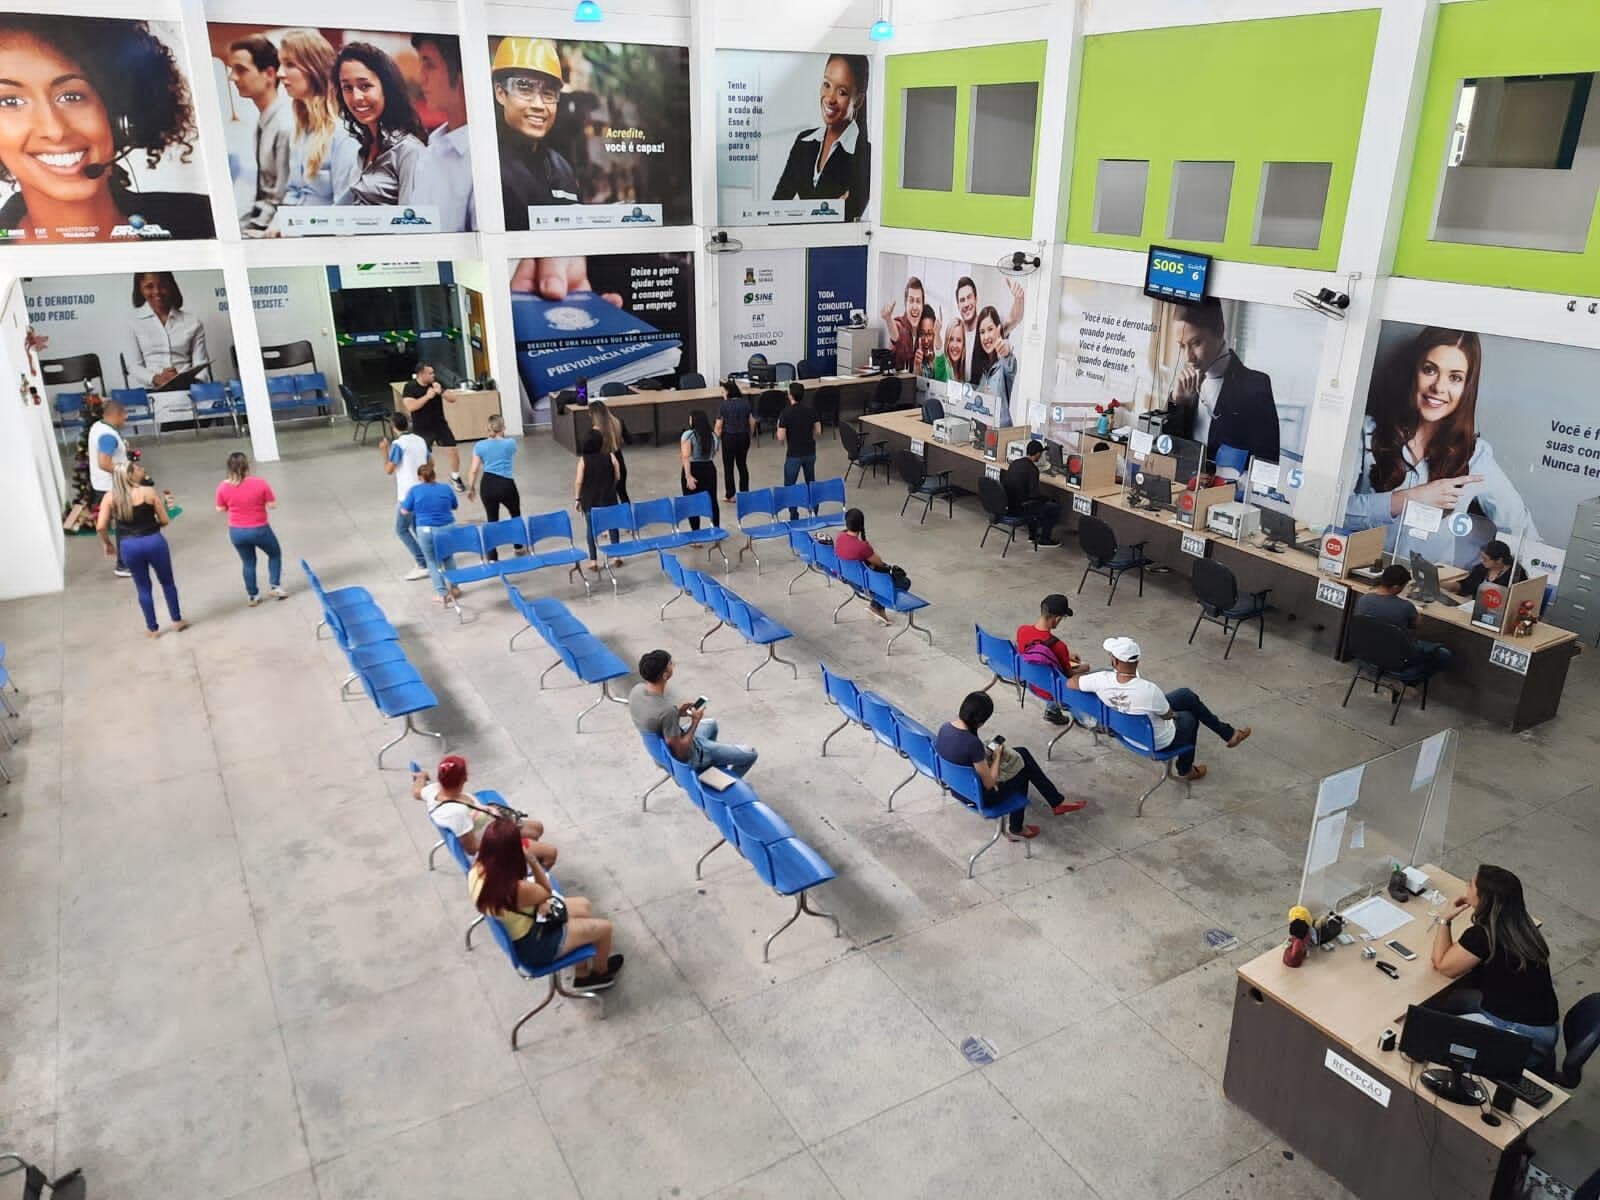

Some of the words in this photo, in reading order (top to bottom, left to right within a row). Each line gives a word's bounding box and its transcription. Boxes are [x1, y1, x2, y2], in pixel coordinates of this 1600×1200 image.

[728, 81, 747, 89] Tente
[738, 95, 763, 104] superar
[734, 106, 750, 114] cada
[728, 118, 744, 126] Esse
[746, 117, 750, 126] é
[606, 128, 646, 140] Acredite,
[735, 130, 761, 139] segredo
[605, 141, 626, 152] você
[628, 141, 634, 152] é
[636, 142, 665, 155] capaz!
[728, 143, 743, 151] para
[631, 266, 651, 276] Deixe
[659, 267, 680, 277] gente
[1153, 259, 1184, 274] S005
[1192, 272, 1199, 280] 6
[632, 278, 654, 290] ajudar
[656, 277, 673, 287] você
[638, 288, 674, 300] conseguir
[754, 292, 773, 301] SINE
[38, 296, 42, 307] É
[45, 294, 95, 307] DERROTADO
[646, 301, 677, 311] emprego
[818, 302, 853, 310] CONQUISTA
[48, 310, 79, 320] PERDE.
[818, 314, 843, 323] COMEÇA
[1102, 316, 1114, 325] não
[1122, 319, 1157, 332] derrotado
[772, 330, 784, 338] DO
[1080, 327, 1104, 337] quando
[1105, 332, 1127, 342] perde.
[527, 342, 557, 350] DESISTIR
[625, 334, 637, 342] NÃO
[740, 340, 777, 348] TRABALHO
[817, 349, 824, 357] DE
[1080, 340, 1094, 350] Você
[1096, 343, 1100, 352] é
[1102, 344, 1135, 358] derrotado
[546, 350, 621, 377] PREVIDÊNCIA
[1077, 355, 1101, 366] quando
[1055, 406, 1062, 423] 3
[1552, 420, 1581, 436] Você
[1584, 426, 1592, 439] é
[1160, 436, 1169, 454] 4
[1545, 440, 1574, 454] suas
[1542, 455, 1580, 473] Nunca
[1289, 468, 1302, 488] 5
[1453, 513, 1467, 535] 6
[1333, 1058, 1382, 1097] RECEPÇÃO
